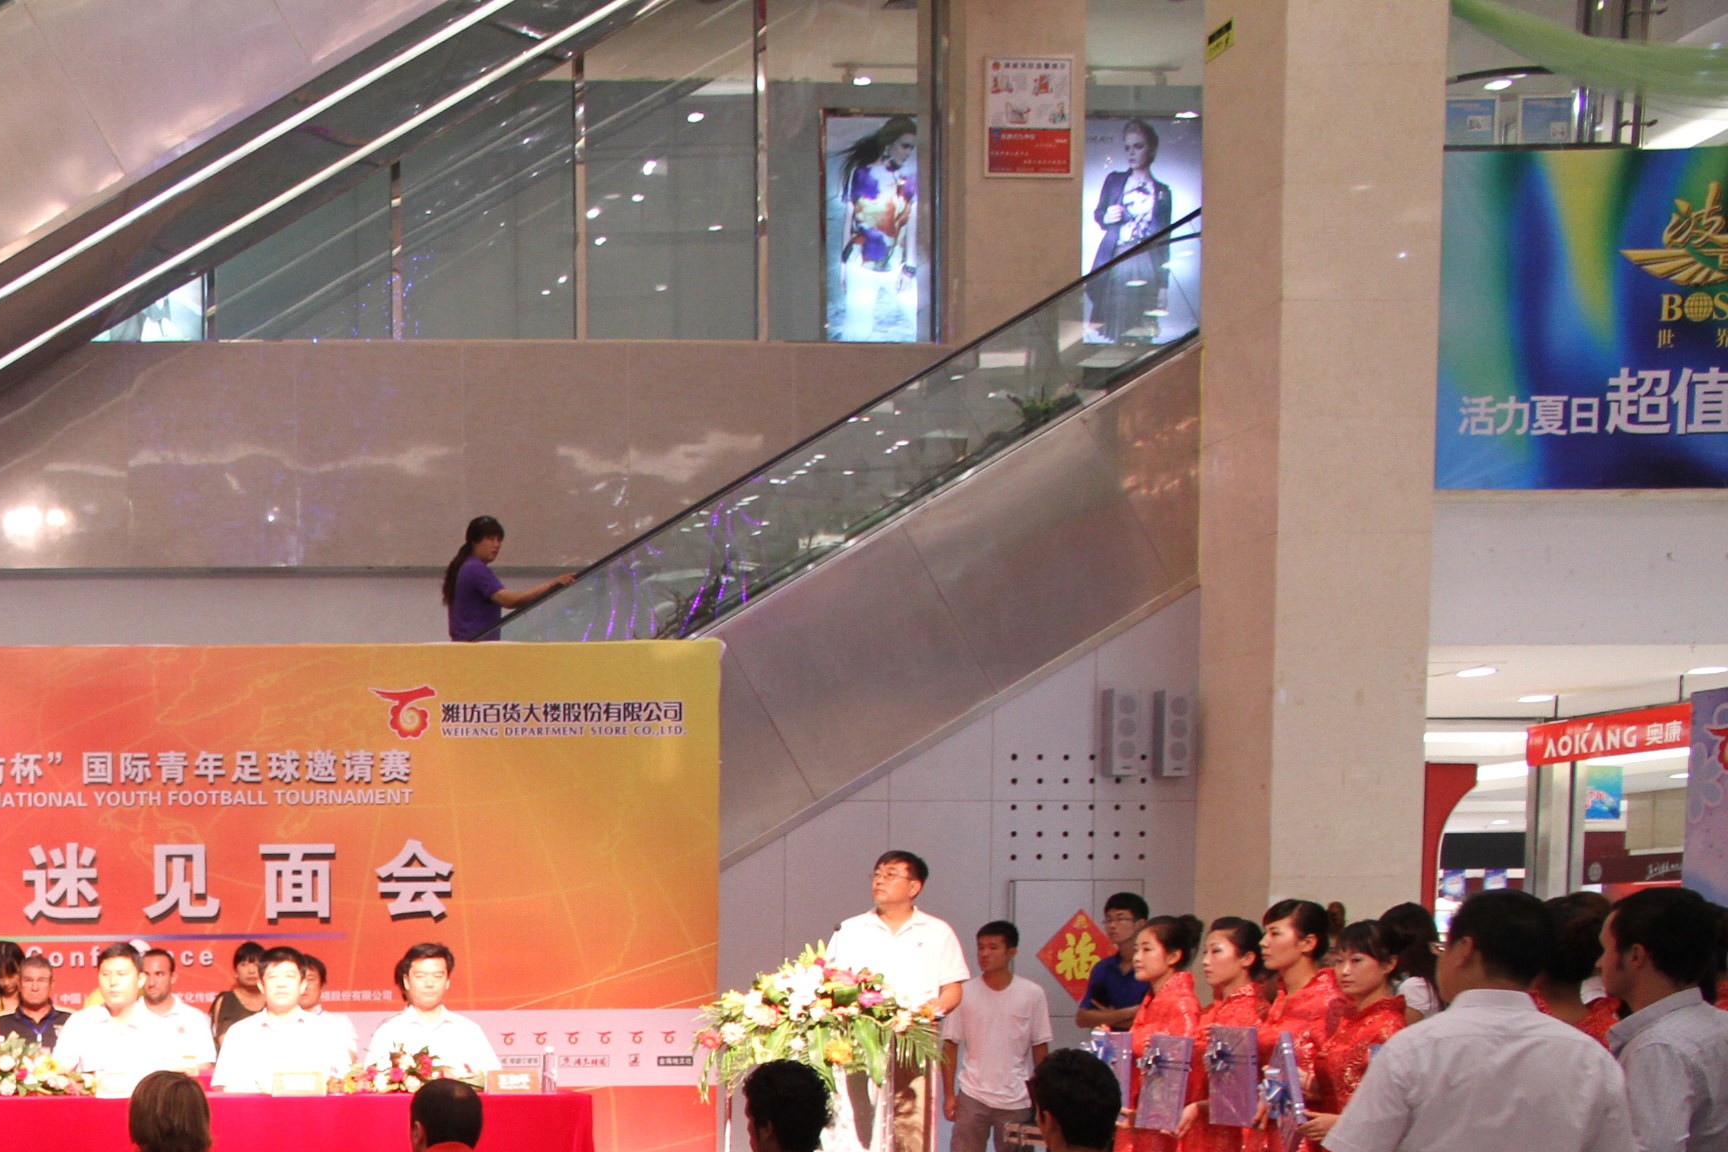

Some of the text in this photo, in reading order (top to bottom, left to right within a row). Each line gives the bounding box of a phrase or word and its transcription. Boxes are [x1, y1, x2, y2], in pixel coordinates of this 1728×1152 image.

[441, 701, 684, 723] 潍坊百货大楼股份有限公司
[442, 727, 499, 737] WEIFANG
[505, 726, 585, 736] DEPARTMENT
[590, 725, 628, 736] STORE
[81, 749, 412, 786] 国际青年足球邀请赛
[93, 790, 162, 807] YOUTH
[167, 789, 268, 806] FOOTBALL
[273, 788, 414, 805] TOURNAMENT
